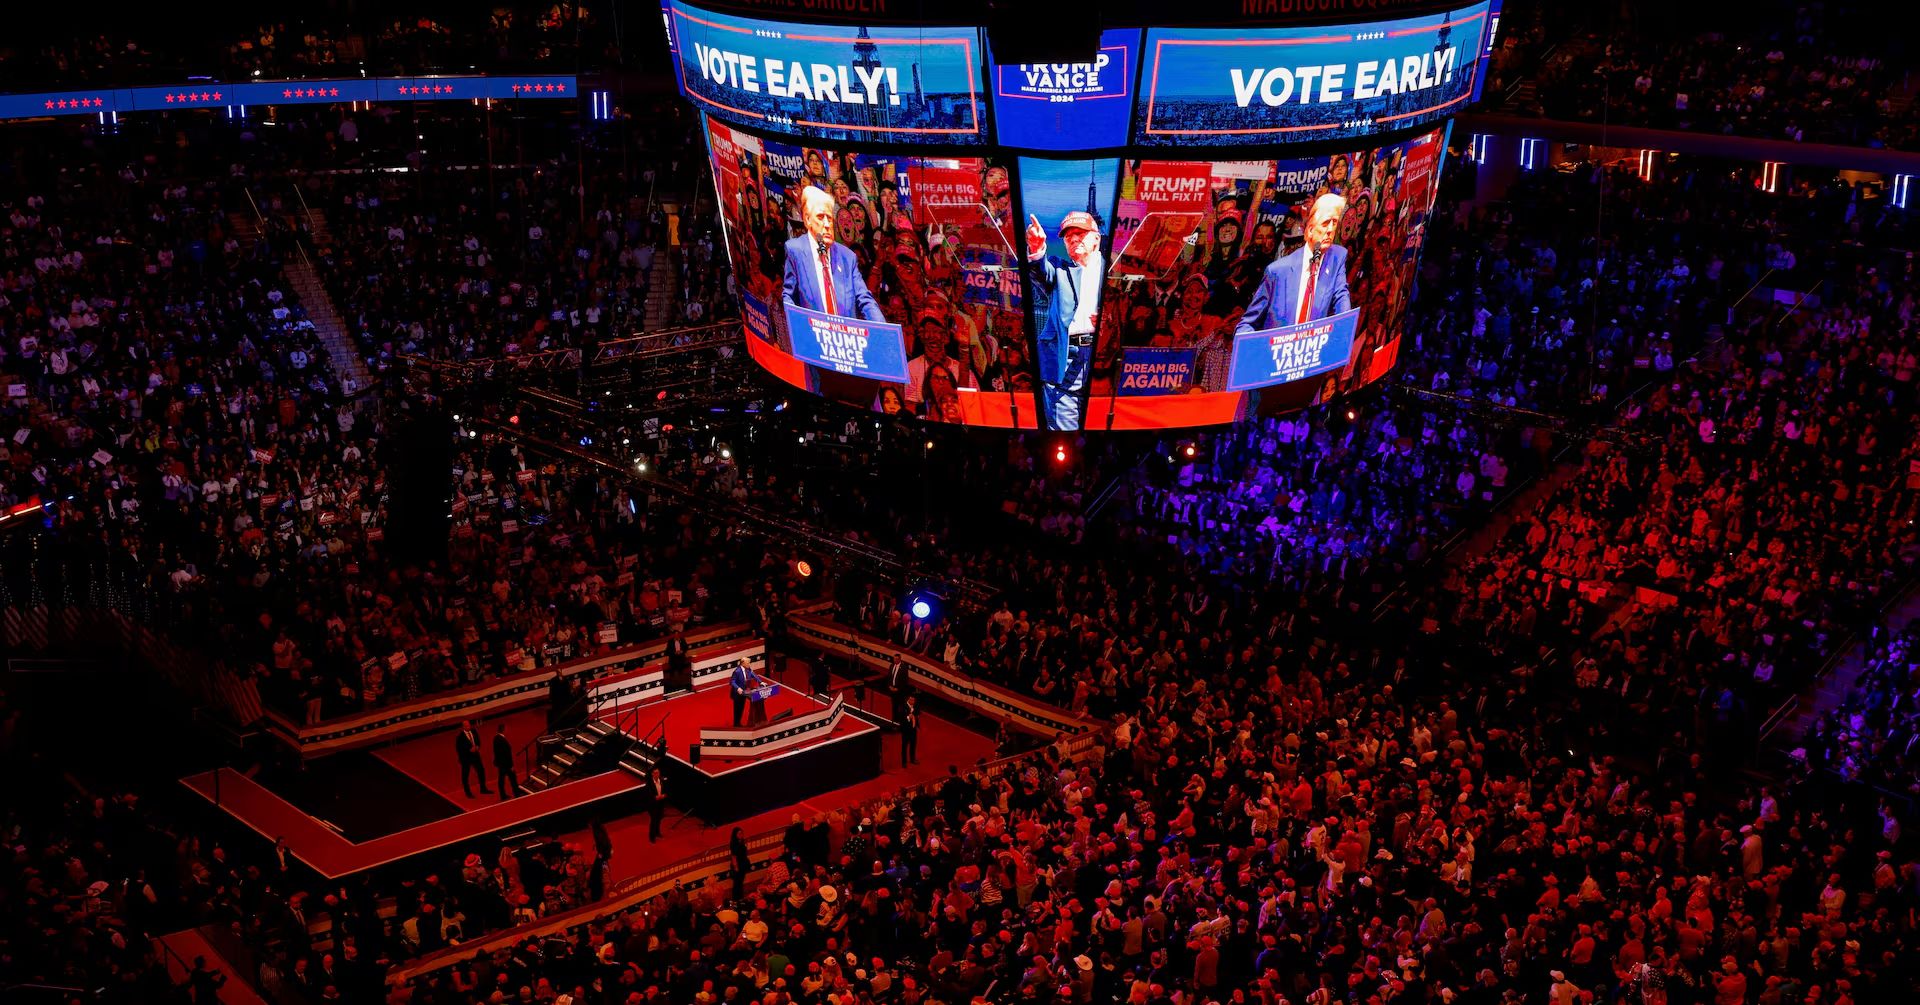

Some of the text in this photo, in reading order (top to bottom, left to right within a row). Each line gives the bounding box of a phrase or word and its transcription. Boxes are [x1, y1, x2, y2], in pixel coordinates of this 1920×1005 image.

[694, 42, 901, 106] VOTE EARLY!
[1026, 72, 1098, 88] VANCE
[1230, 46, 1457, 107] VOTE EARLY!
[712, 132, 733, 153] TRUMP
[765, 152, 804, 170] TRUMP
[768, 165, 805, 179] WILL FIX IT
[1278, 166, 1328, 186] TRUMP
[915, 183, 953, 193] DREAM
[956, 184, 978, 195] BIG,
[1141, 176, 1207, 193] TRUMP
[1276, 179, 1326, 194] WILL FIX IT
[920, 194, 974, 206] AGAIN!
[1140, 192, 1204, 202] WILL FIX IT
[811, 318, 866, 336] TRUMP WILL FIX IT
[1272, 326, 1331, 344] TRUMP WILL FIX IT
[812, 327, 868, 352] TRUMP
[1271, 334, 1329, 360] TRUMP
[820, 342, 864, 364] VANCE
[1275, 350, 1321, 371] VANCE
[836, 363, 853, 374] 2024
[1123, 363, 1190, 375] DREAM BIG,
[1286, 371, 1305, 381] 2024
[1122, 374, 1184, 389] AGAIN!
